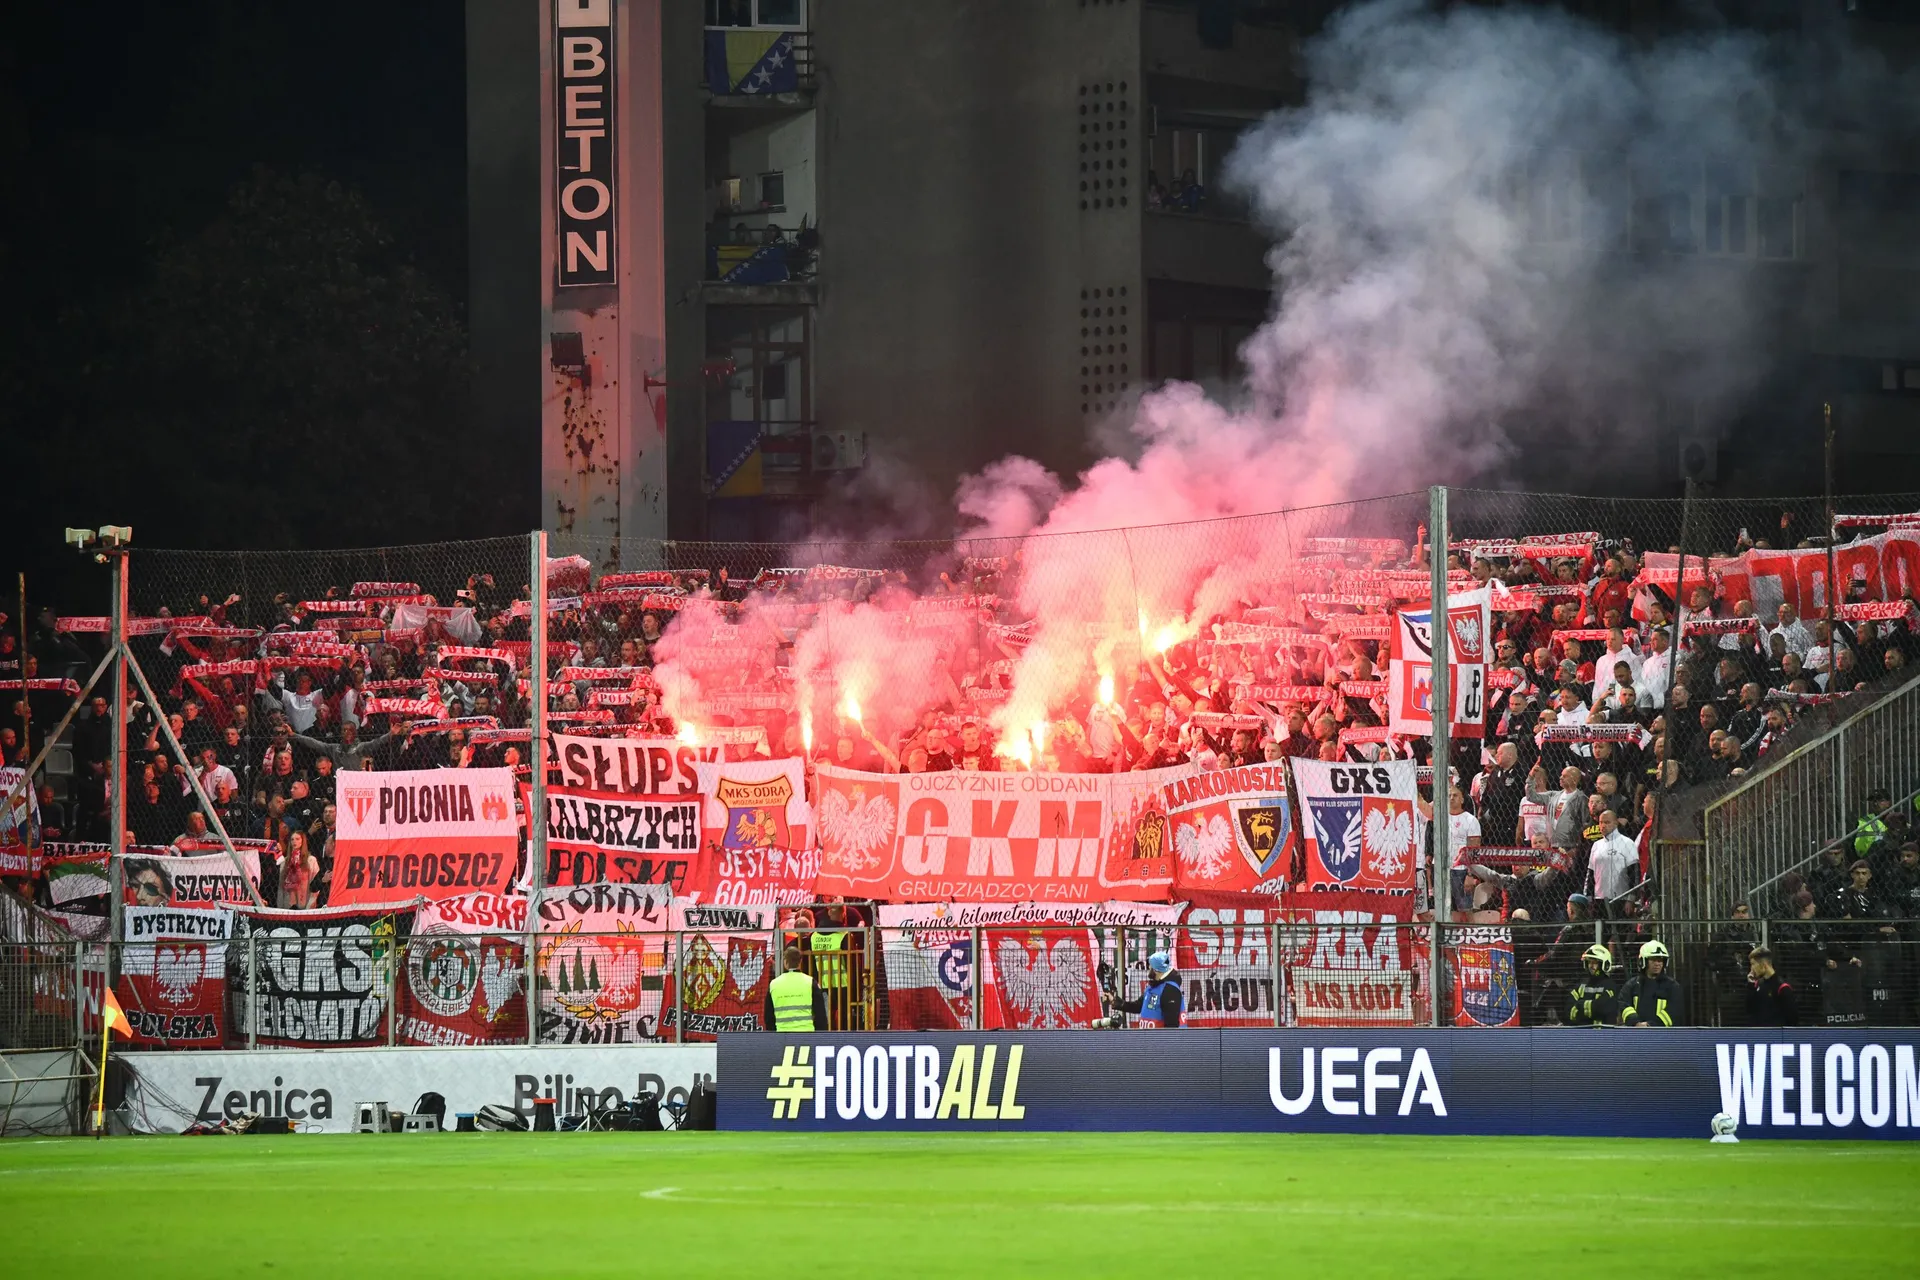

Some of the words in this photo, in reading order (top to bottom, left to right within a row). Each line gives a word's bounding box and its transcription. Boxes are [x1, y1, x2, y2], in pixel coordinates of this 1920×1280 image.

[562, 36, 611, 272] BETON
[299, 645, 351, 656] POLSK
[380, 698, 433, 713] POLSKA
[1254, 686, 1313, 700] POLSKA
[911, 774, 1014, 792] OJCZYŹNIE
[1021, 777, 1098, 793] ODDANI
[1164, 766, 1285, 810] KARKONOSZE
[1330, 768, 1392, 794] GKS
[379, 784, 475, 825] POLONIA
[901, 797, 1101, 877] GKM
[346, 853, 503, 889] BYDGOSZCZ
[719, 848, 767, 878] JEST
[714, 879, 747, 905] 60
[898, 880, 1039, 900] GRUDZIĄDZCY
[1044, 883, 1088, 898] FANI
[133, 914, 226, 938] BYSTRZYCA
[684, 909, 762, 929] CZUWAJ
[958, 902, 1049, 927] kilometrów
[1304, 980, 1343, 1010] ŁKS
[1350, 976, 1405, 1011] ŁÓDŹ
[126, 1010, 218, 1039] POLSKA
[766, 1045, 1025, 1120] #FOOTBALL
[1268, 1047, 1447, 1116] UEFA
[195, 1076, 333, 1121] Zenica
